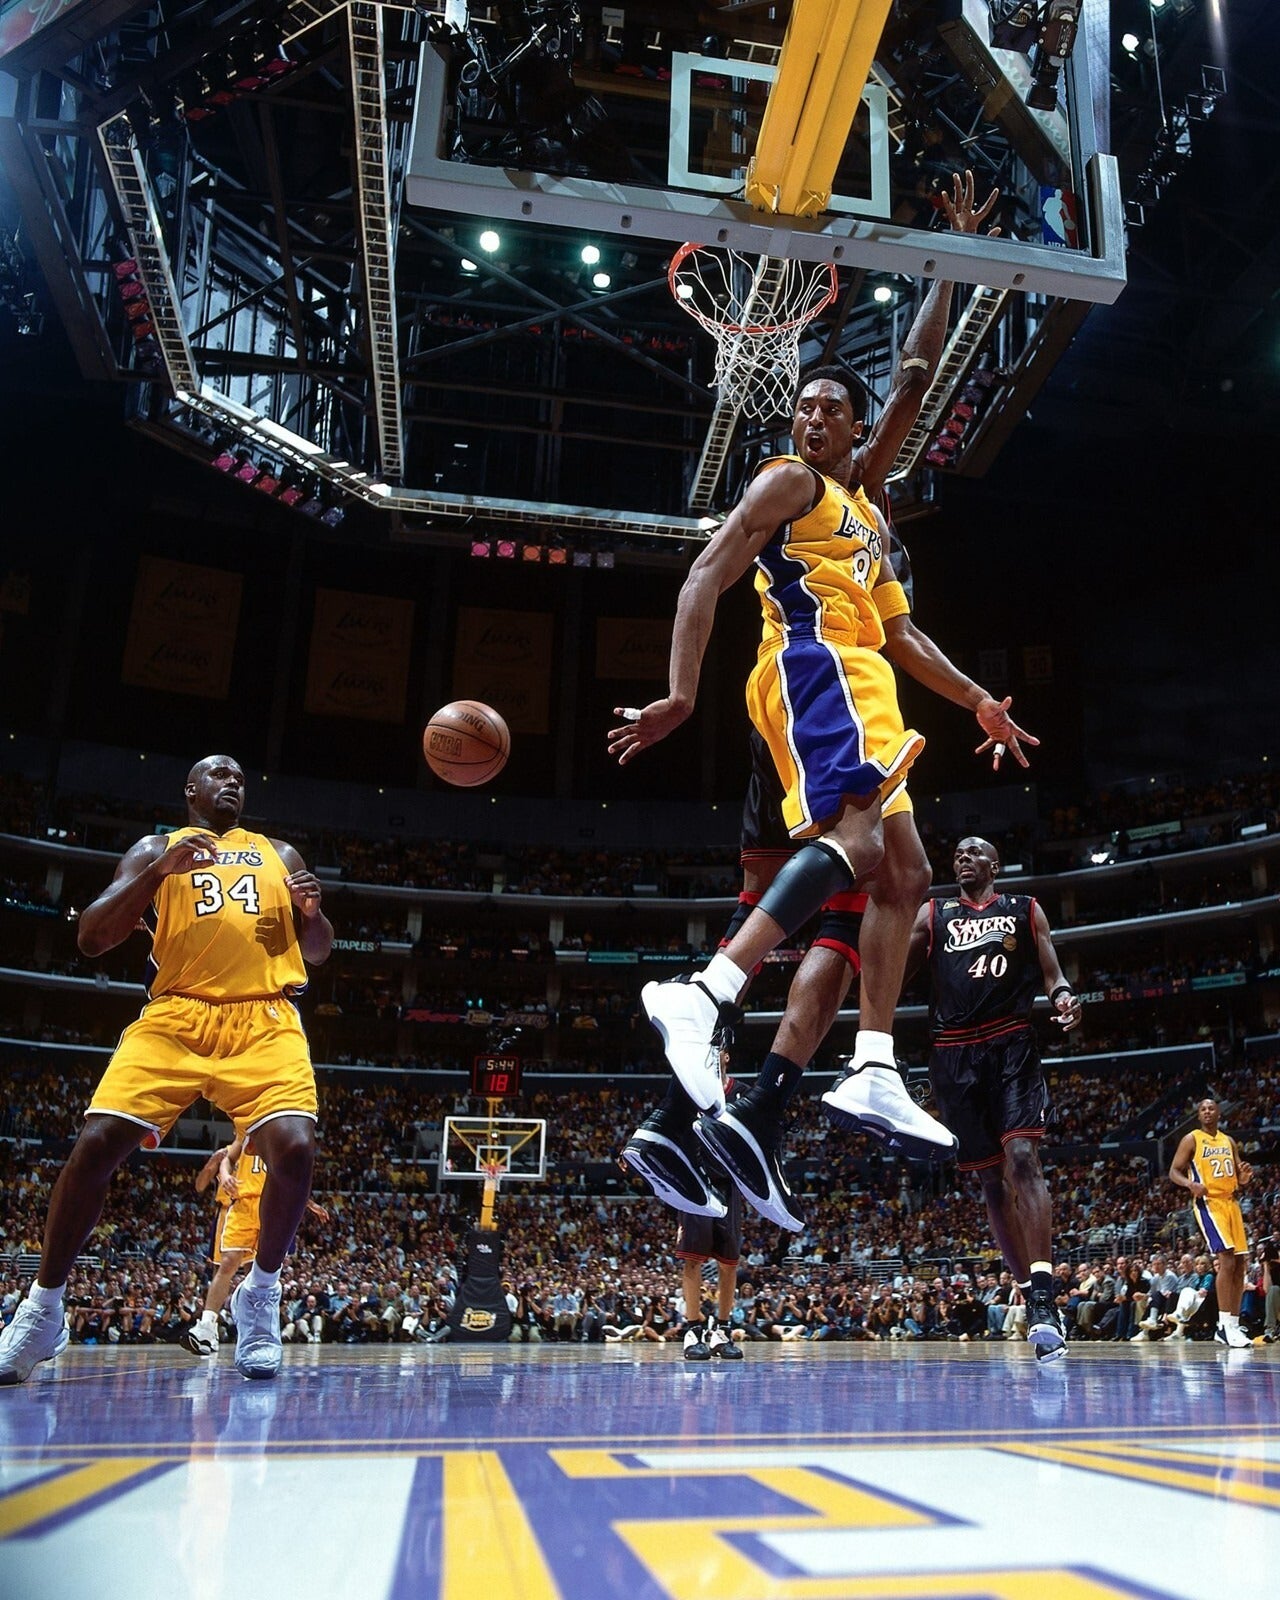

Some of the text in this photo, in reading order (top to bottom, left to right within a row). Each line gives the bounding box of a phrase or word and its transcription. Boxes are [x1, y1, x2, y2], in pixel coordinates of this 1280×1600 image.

[193, 851, 263, 867] AKERS
[191, 872, 260, 917] 34
[946, 915, 1017, 947] SIXERS
[331, 939, 375, 952] STAPLES
[967, 953, 1008, 978] 40
[486, 1060, 515, 1071] 5:44
[489, 1074, 510, 1092] 18
[1203, 1146, 1231, 1158] LAKERS
[1210, 1159, 1234, 1178] 20
